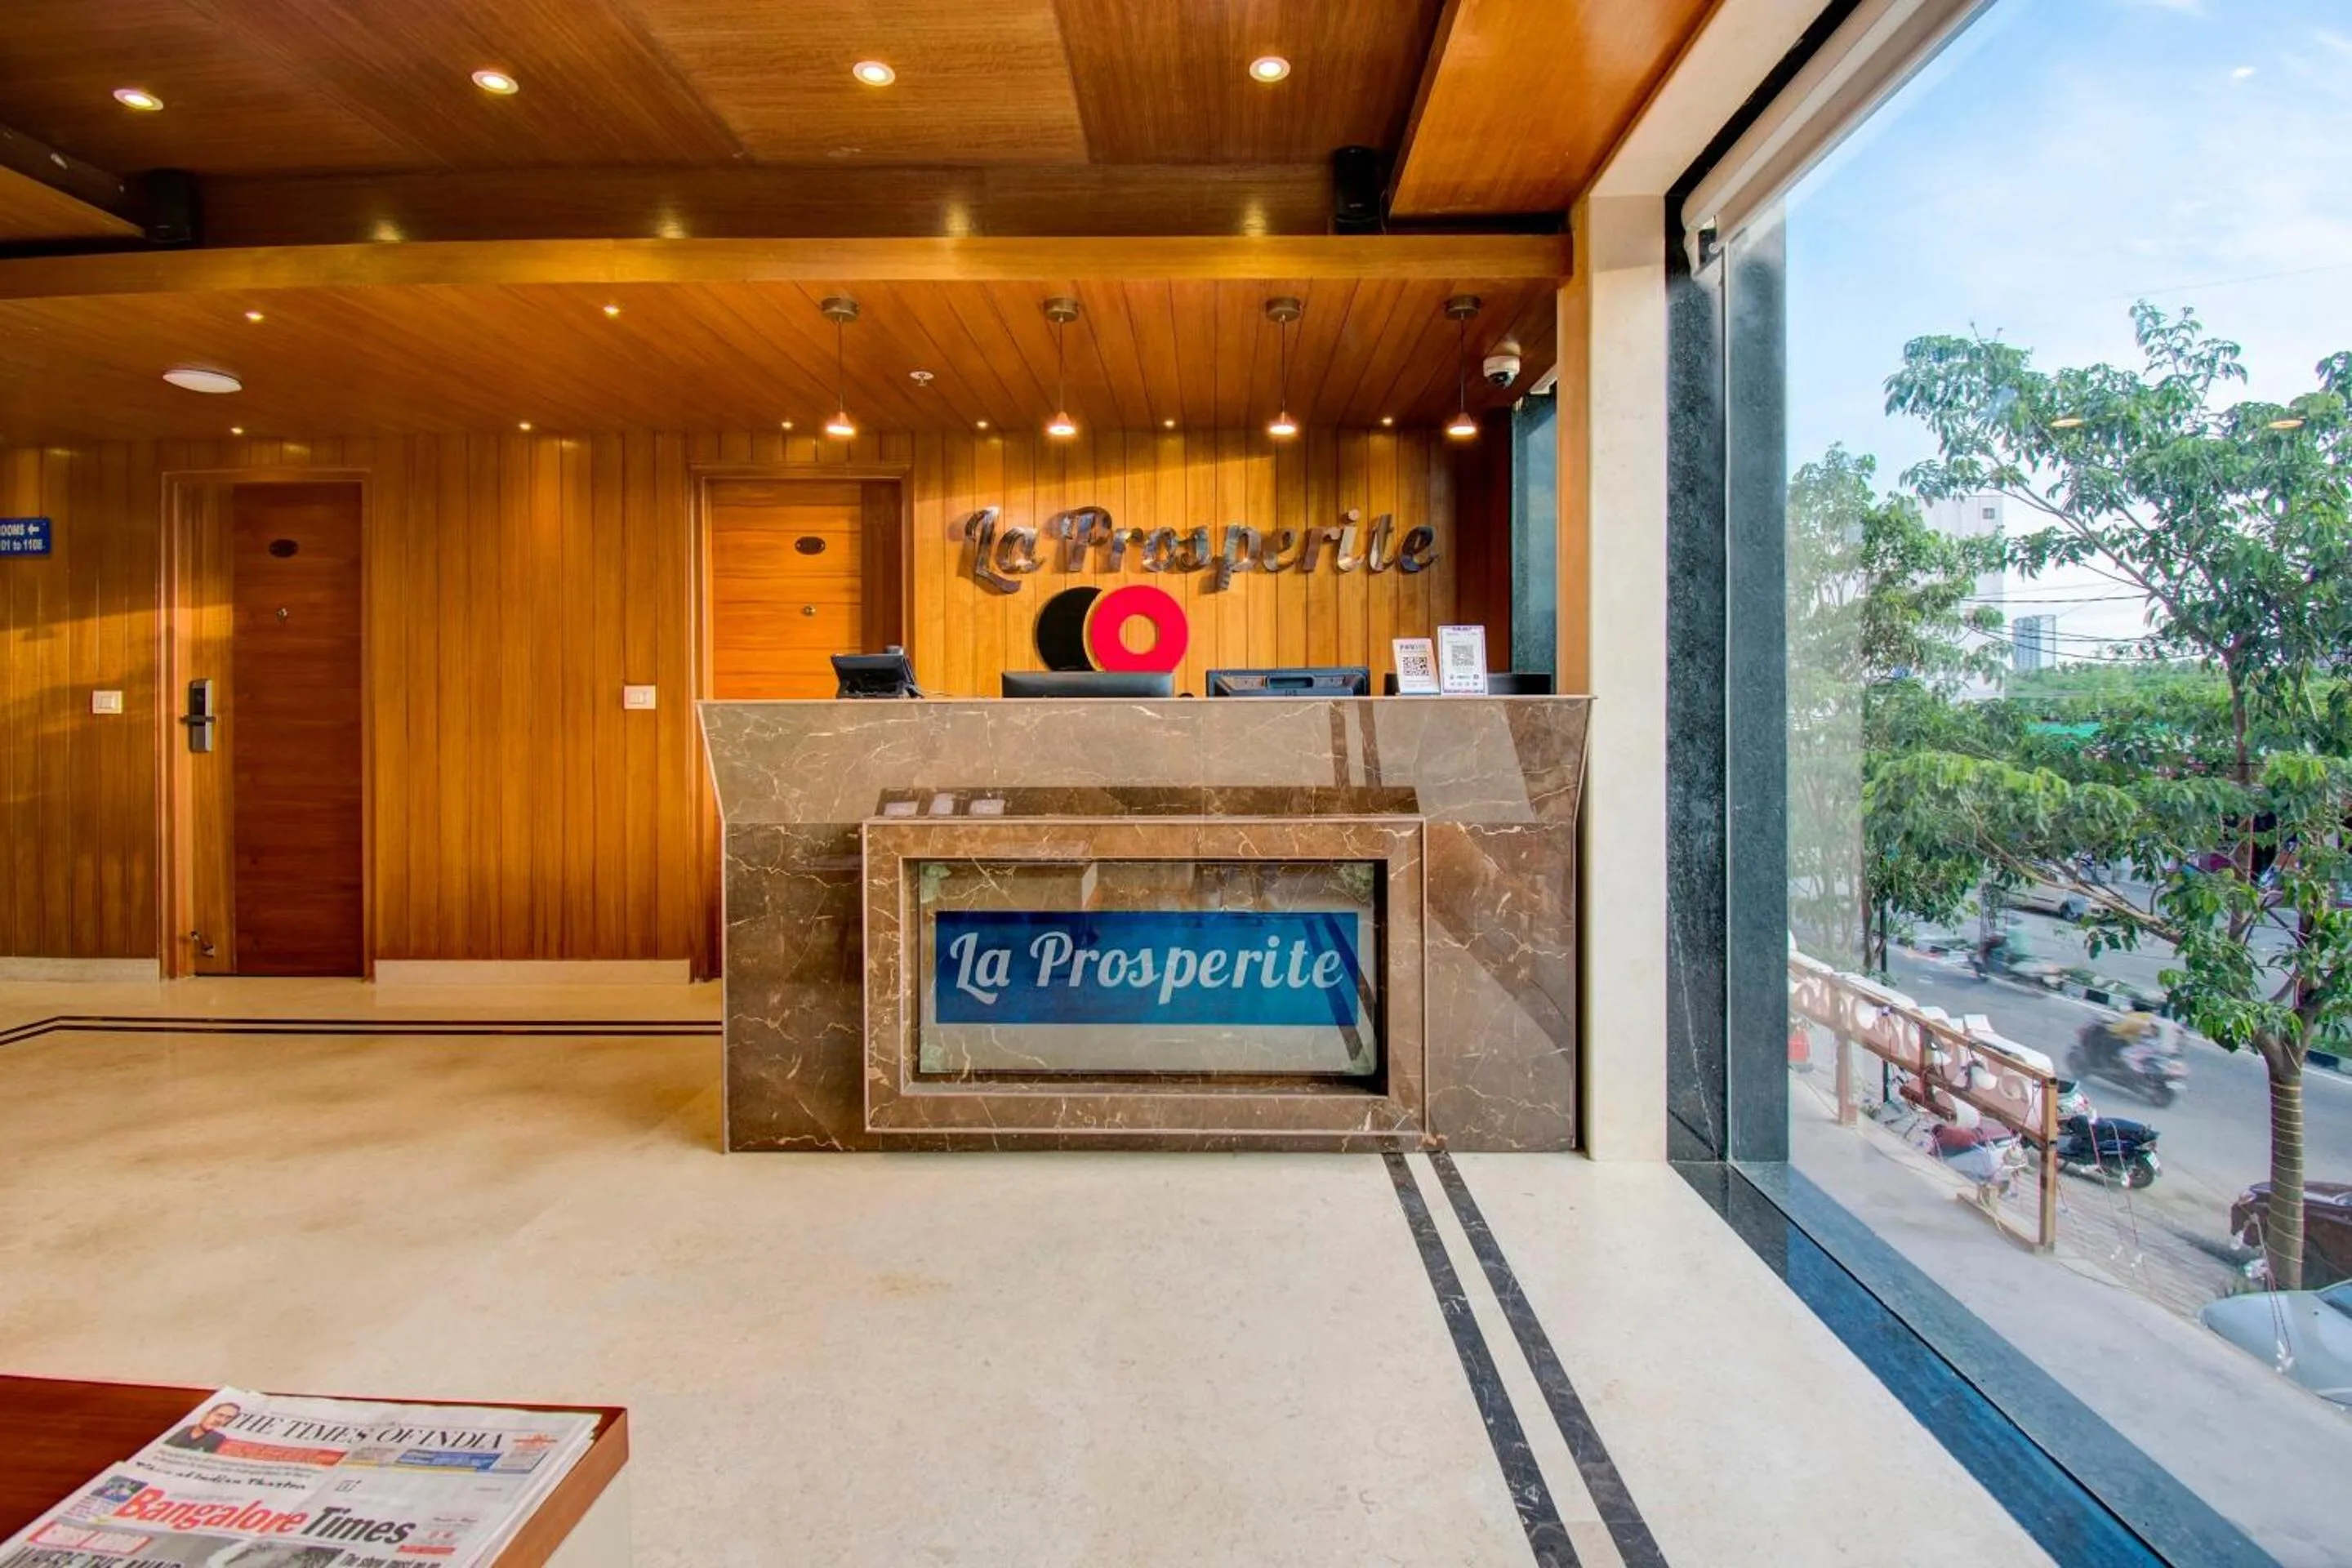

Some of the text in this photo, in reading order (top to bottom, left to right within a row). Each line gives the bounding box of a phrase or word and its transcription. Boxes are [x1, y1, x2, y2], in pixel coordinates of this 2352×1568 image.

[0, 524, 24, 537] OOMS
[964, 506, 1441, 594] La Prosperite
[950, 931, 1343, 1004] La Prosperite
[222, 1413, 503, 1450] THE TIMES OF INDIA
[112, 1486, 309, 1533] Bangalore
[301, 1505, 416, 1544] Times
